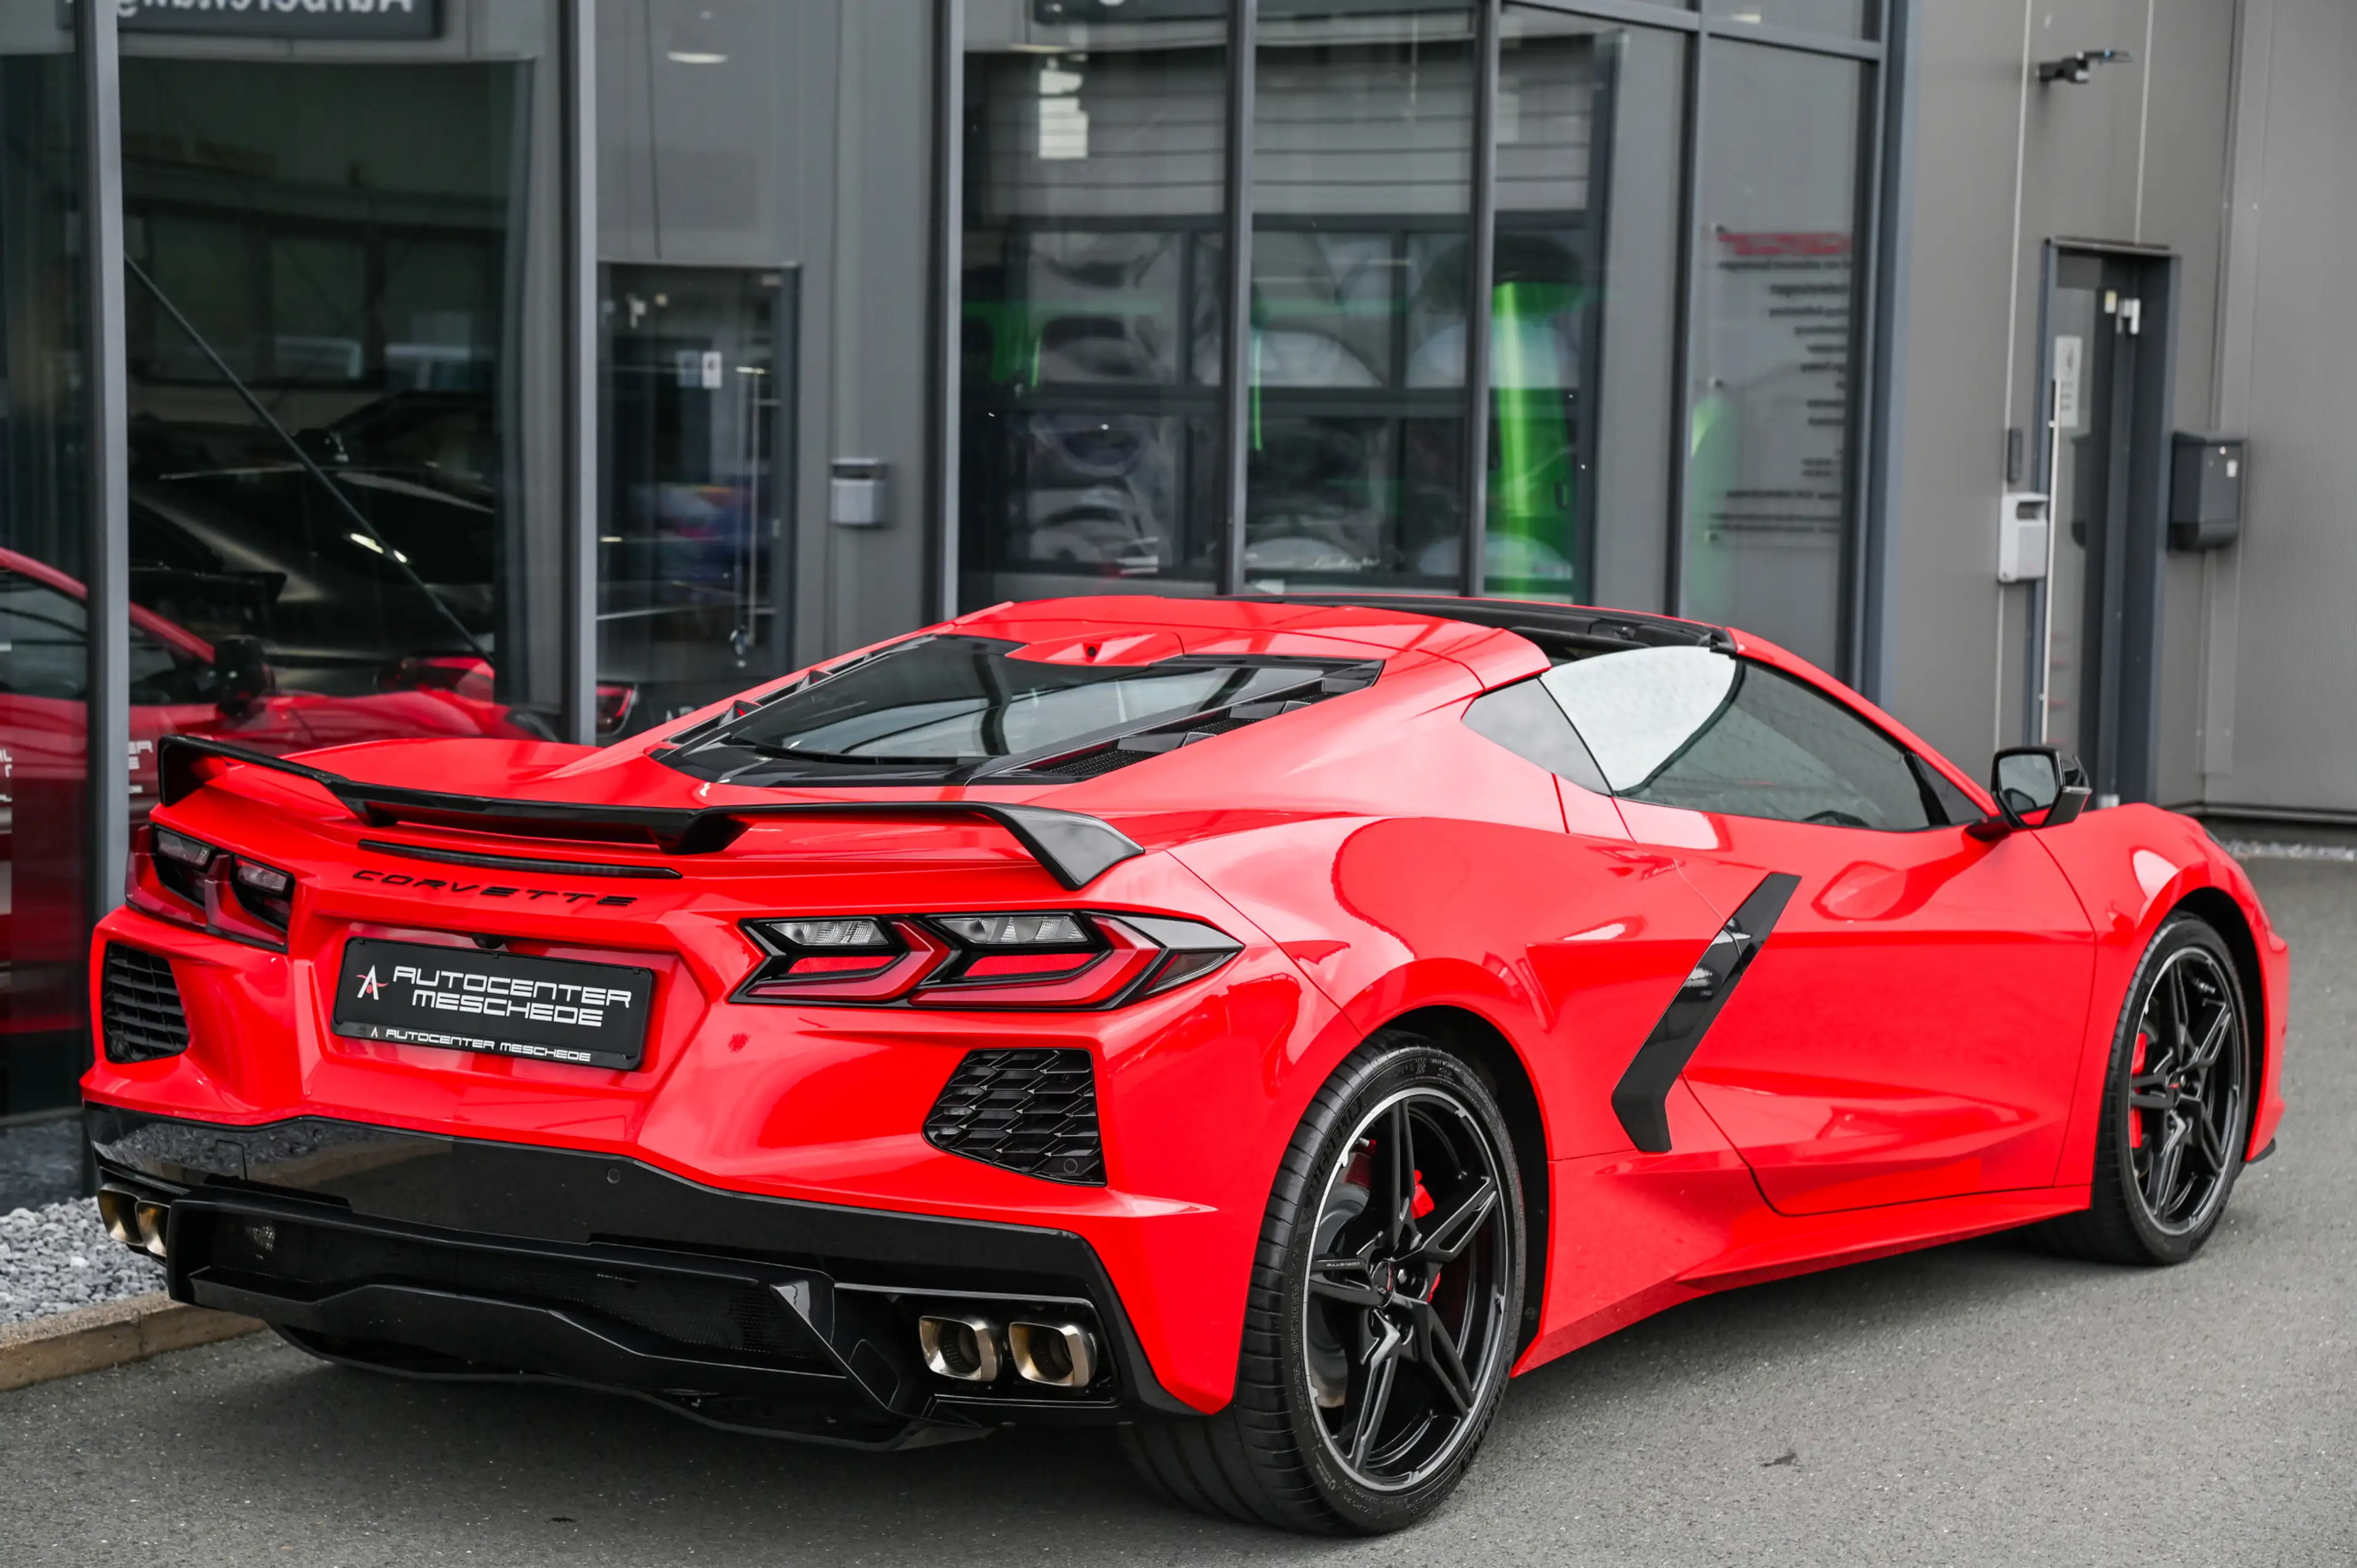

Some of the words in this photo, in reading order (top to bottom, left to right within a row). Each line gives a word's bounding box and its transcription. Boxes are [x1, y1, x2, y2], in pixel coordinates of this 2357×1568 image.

[352, 869, 638, 906] CORVETTE
[393, 966, 632, 1008] AUTOCENTER
[412, 989, 604, 1027] MESCHEDE
[385, 1029, 495, 1050] AUTOCENTER
[500, 1042, 591, 1062] MESCHEDE
